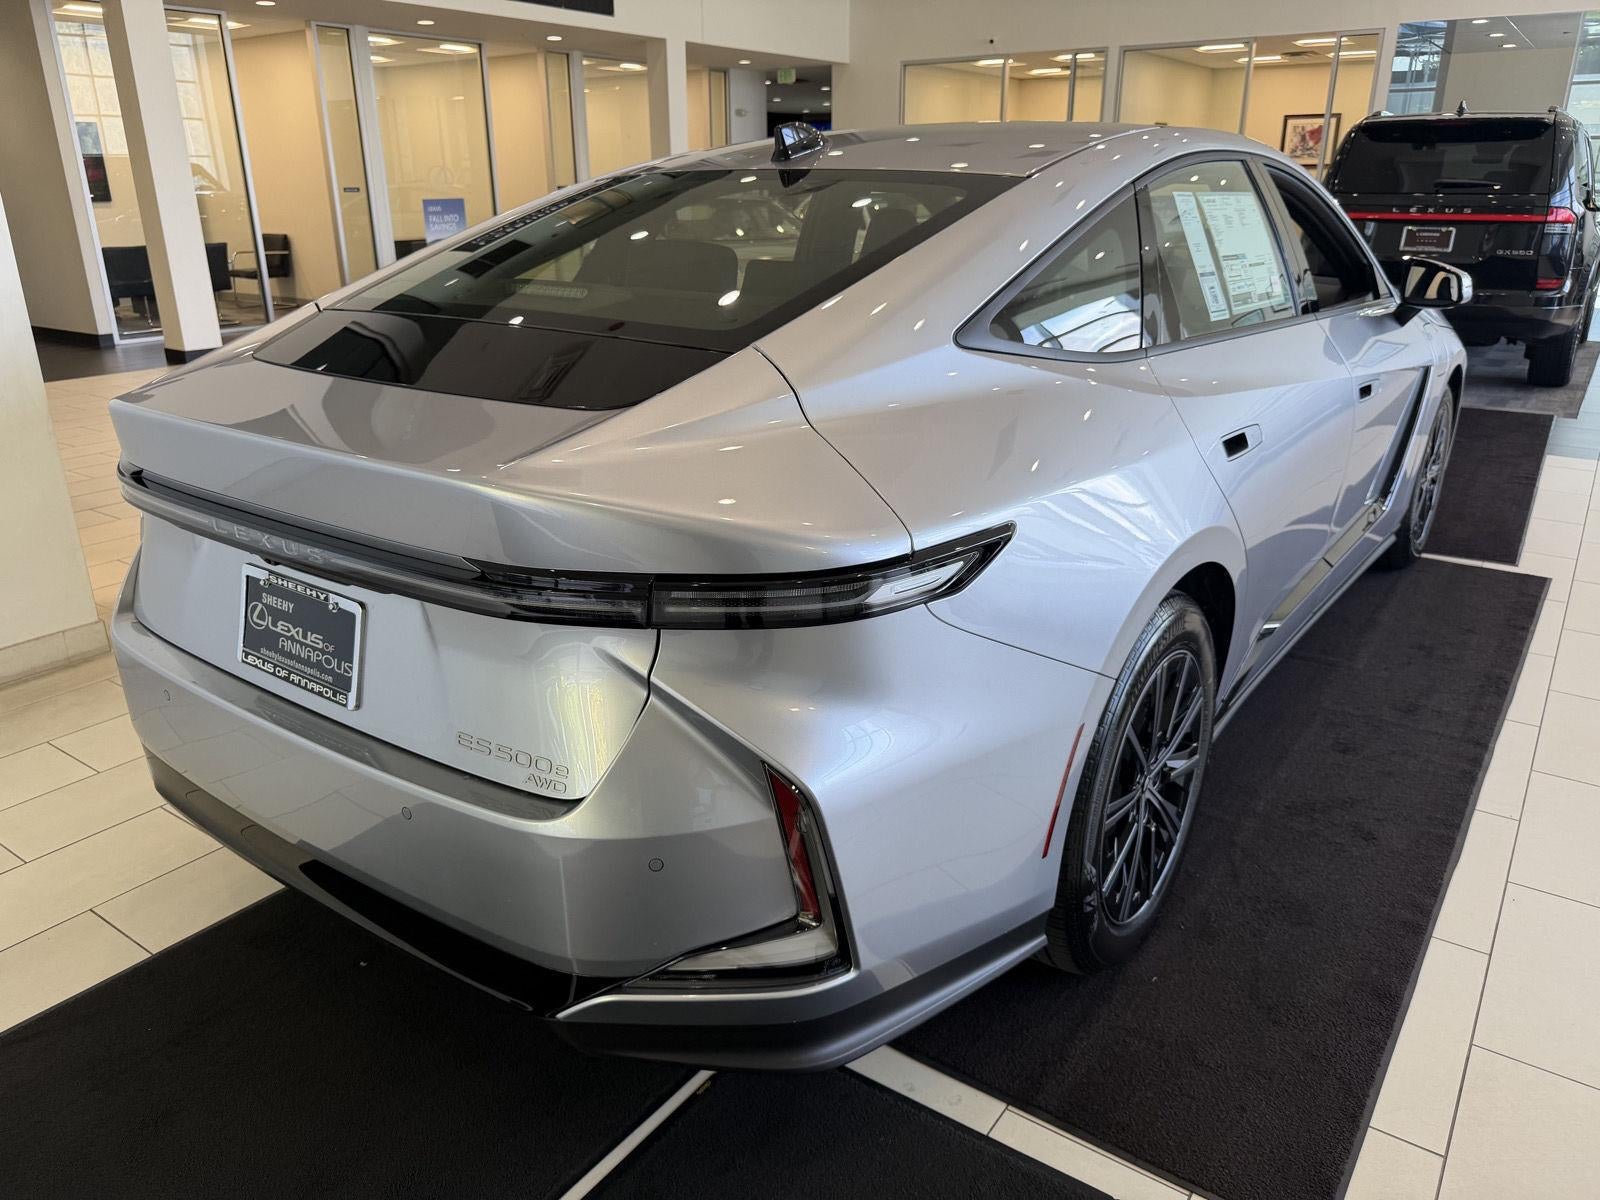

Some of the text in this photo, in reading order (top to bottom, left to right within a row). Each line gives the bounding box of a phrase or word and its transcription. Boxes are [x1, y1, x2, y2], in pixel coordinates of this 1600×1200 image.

[211, 518, 324, 564] LEXUS
[261, 592, 295, 614] SHEEHY
[269, 575, 328, 601] SHEEHY
[268, 616, 335, 653] LEXUS OF
[278, 637, 353, 677] ANNAPOLIS
[242, 652, 347, 705] LEXUS OF ANNAPOLIS
[524, 773, 567, 794] AWD
